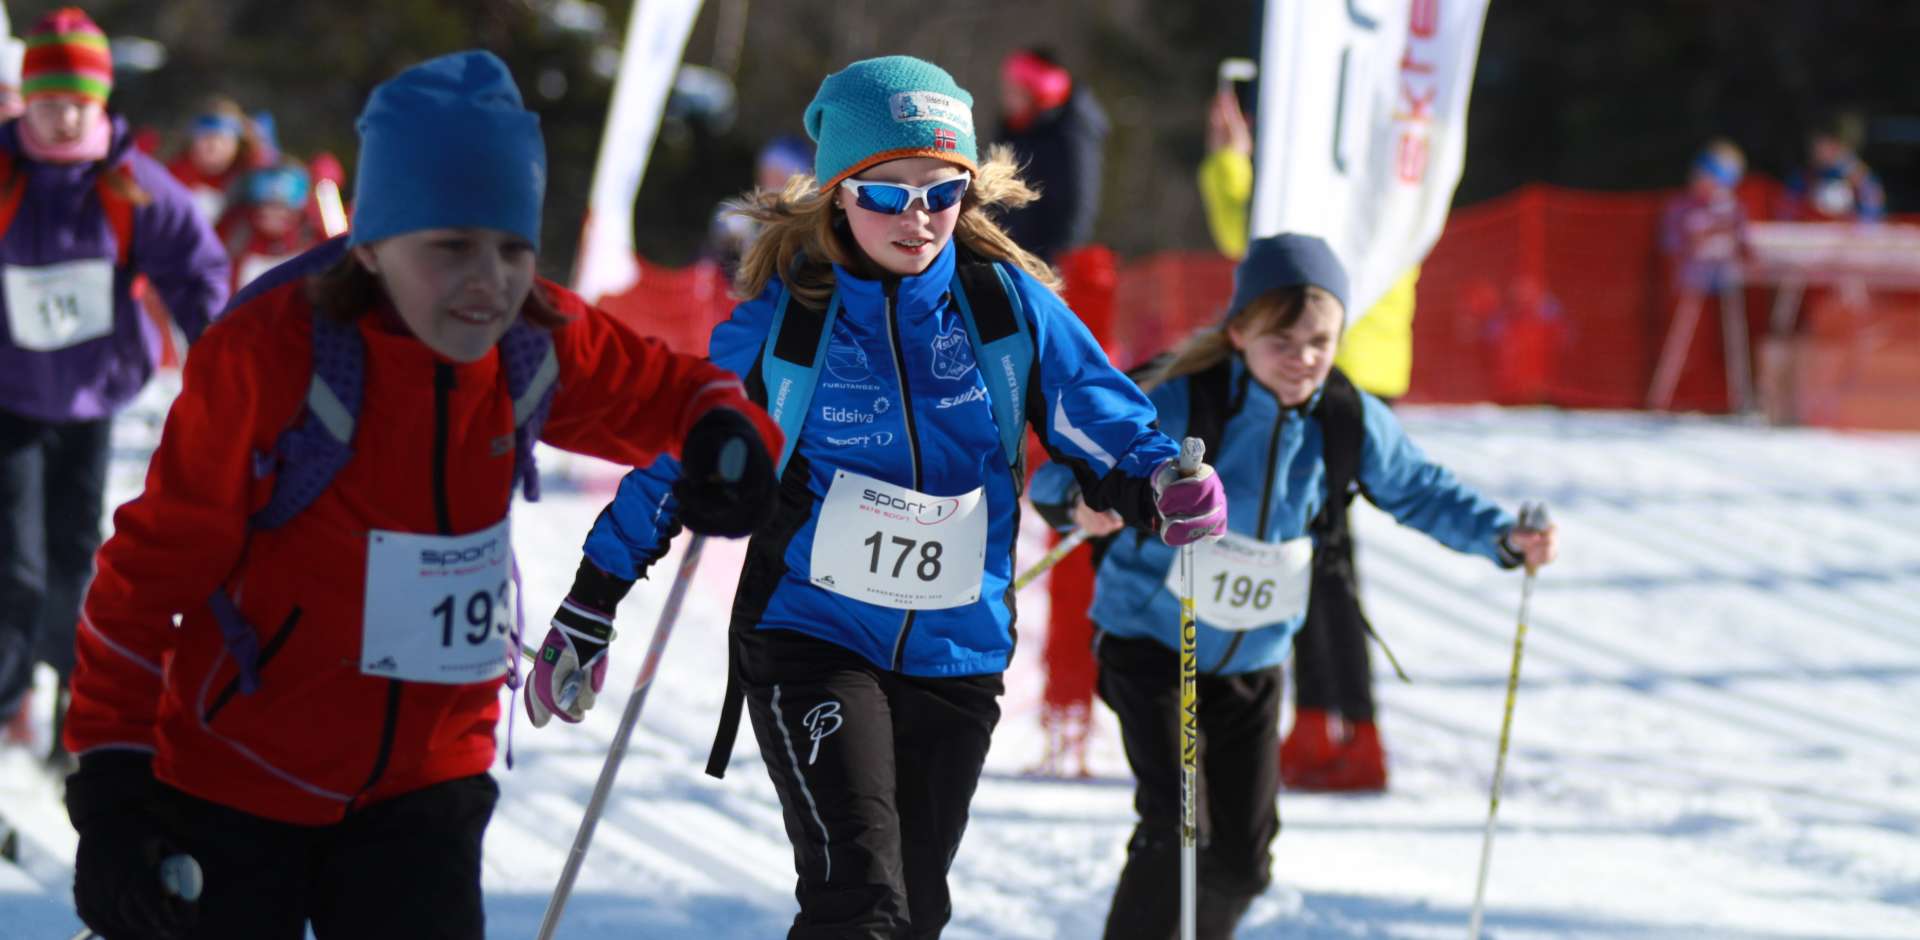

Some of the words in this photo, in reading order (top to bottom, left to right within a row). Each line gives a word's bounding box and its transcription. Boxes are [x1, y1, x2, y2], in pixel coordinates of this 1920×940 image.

[822, 406, 874, 424] Eidsiva
[862, 488, 927, 515] sport
[936, 504, 943, 517] 1
[864, 531, 943, 582] 178
[1212, 571, 1276, 610] 196
